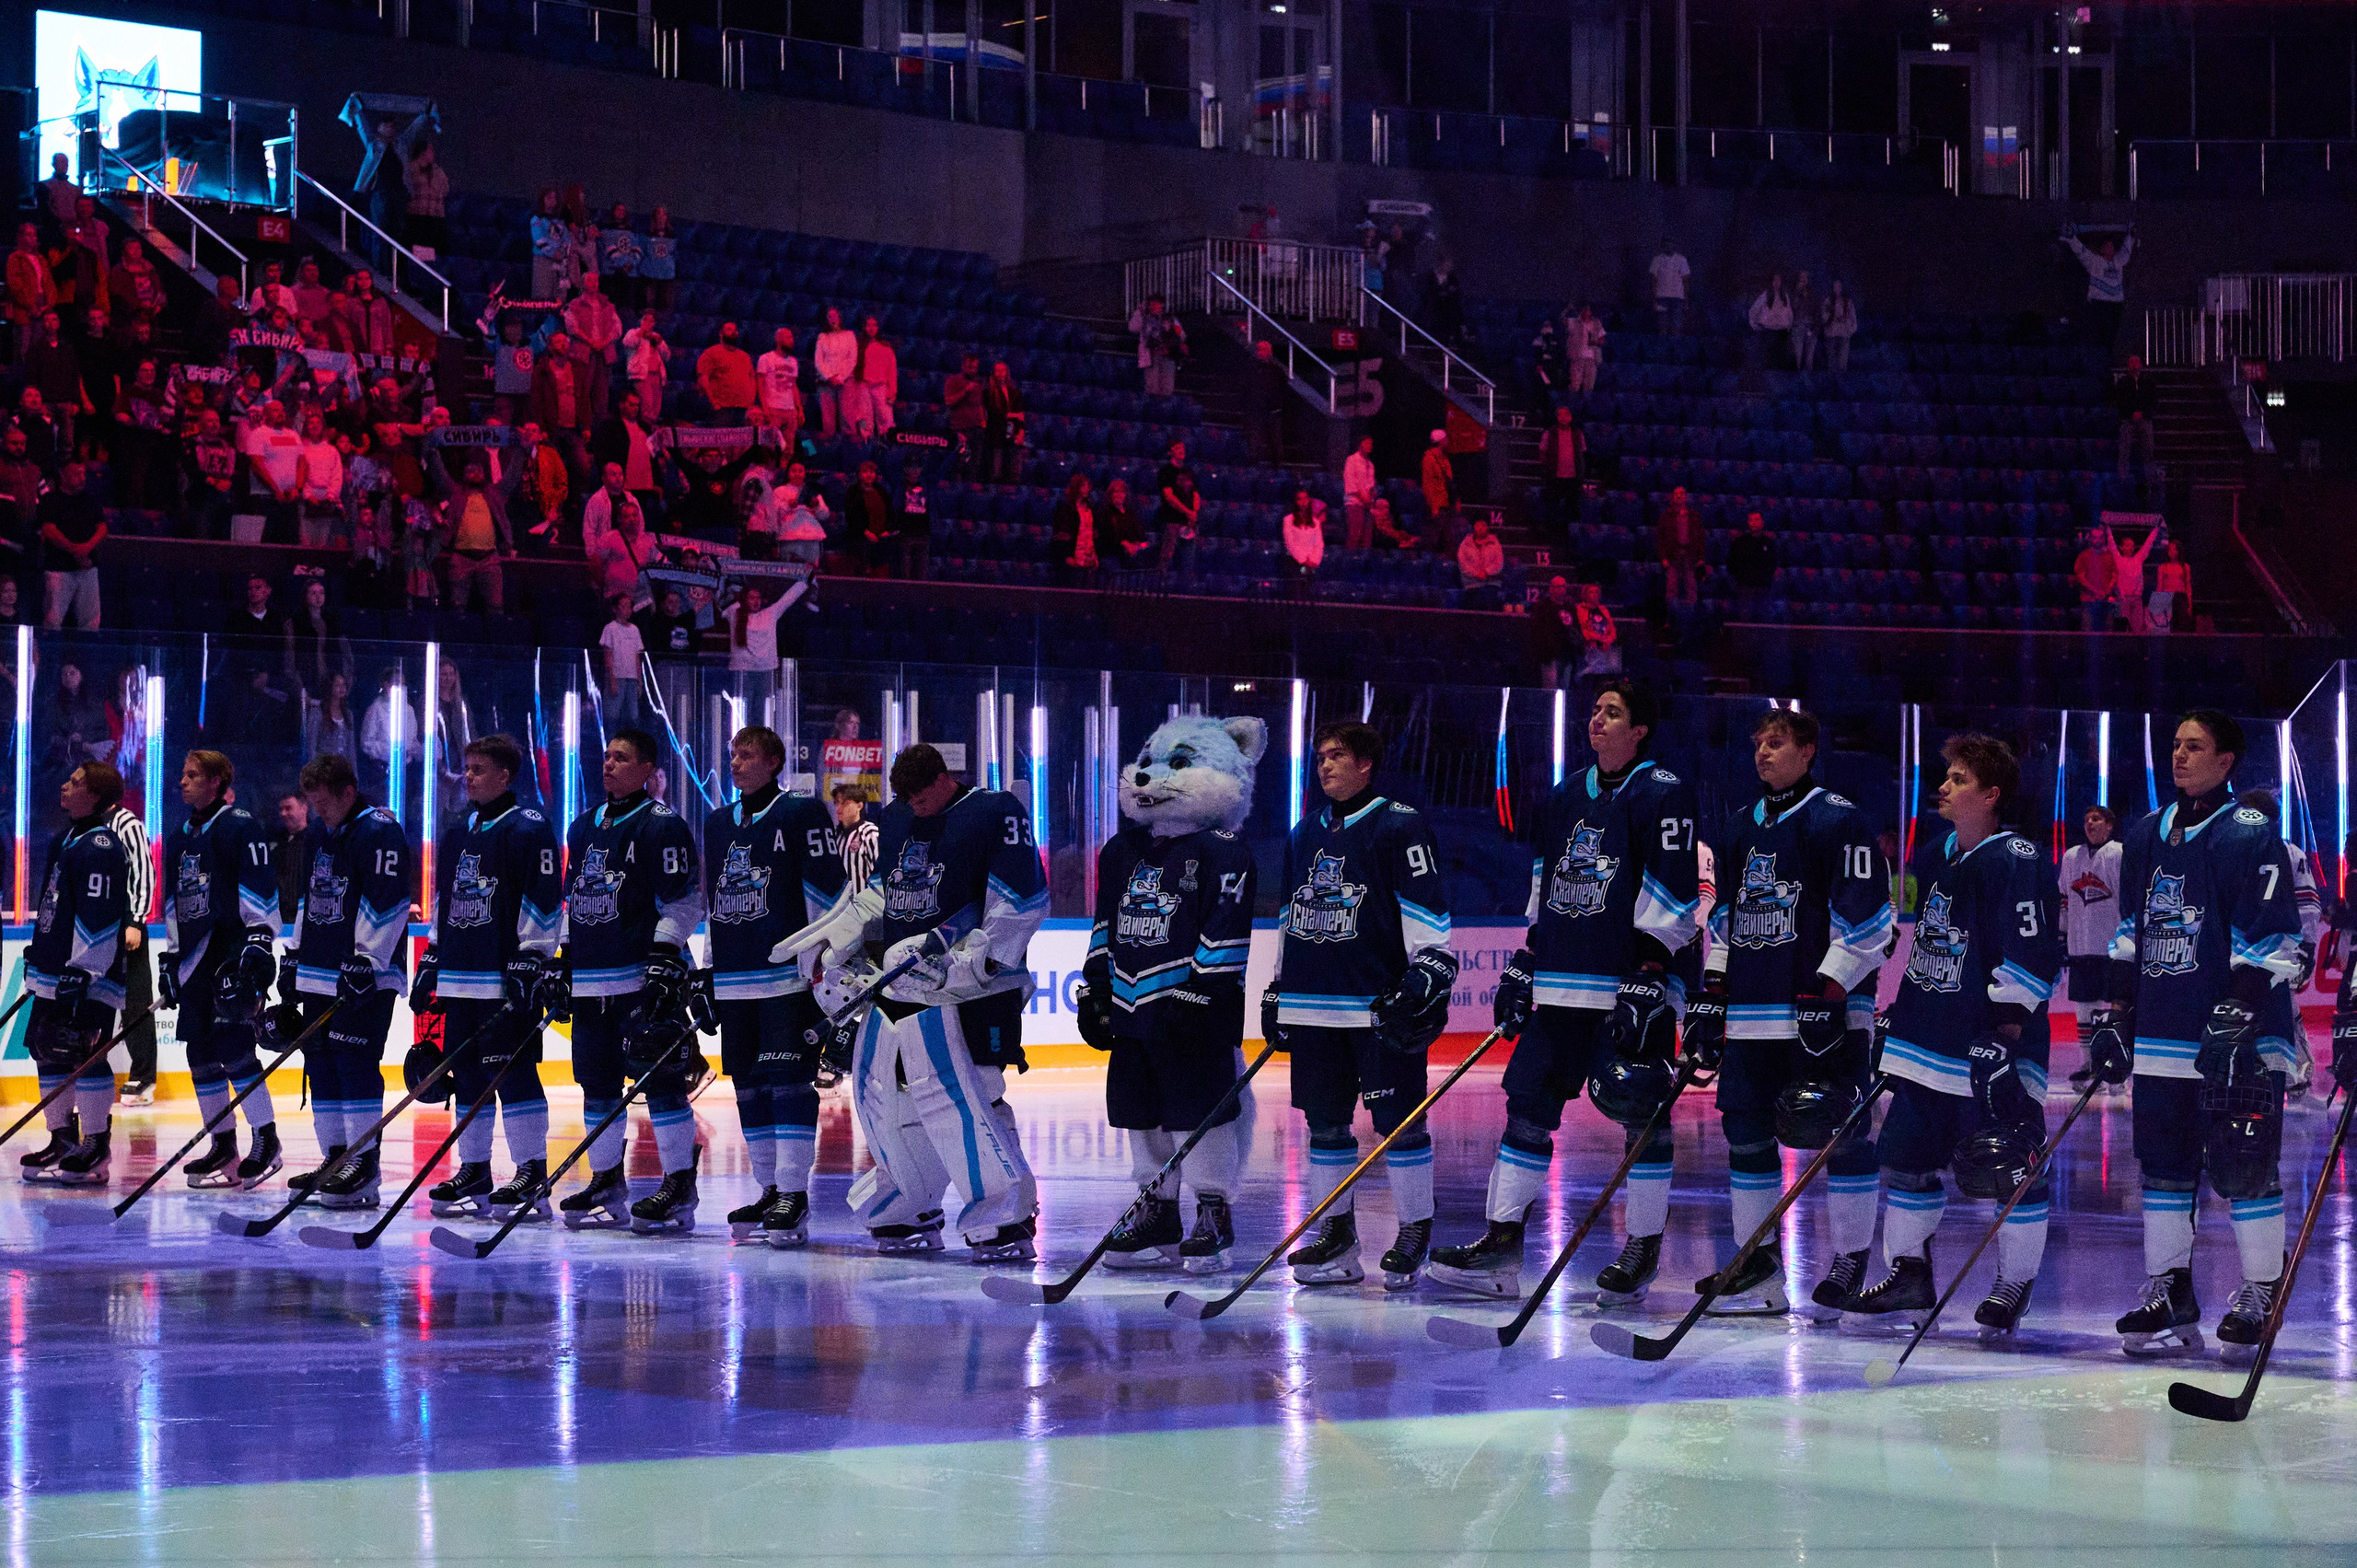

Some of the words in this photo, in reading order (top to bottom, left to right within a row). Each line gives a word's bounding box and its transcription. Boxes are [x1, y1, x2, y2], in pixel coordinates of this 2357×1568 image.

[444, 431, 501, 444] СИБИРЬ
[896, 433, 948, 447] СИБИРЬ
[825, 746, 883, 763] FONBET
[773, 829, 786, 852] A
[1004, 813, 1033, 847] 33
[1661, 818, 1693, 852] 27
[249, 842, 269, 865] 17
[624, 841, 635, 864] A
[807, 828, 838, 857] 56
[376, 848, 399, 877] 12
[540, 849, 553, 875] 8
[662, 847, 689, 875] 83
[1843, 844, 1872, 879] 10
[87, 874, 110, 900] 91
[2258, 865, 2279, 900] 7
[247, 934, 272, 942] CC
[1172, 988, 1212, 1005] PRIME
[328, 1030, 368, 1046] BAUER
[482, 1054, 512, 1064] CCM
[758, 1051, 803, 1063] BAUER
[1364, 1087, 1396, 1100] CCM
[979, 1114, 1017, 1179] TRUE
